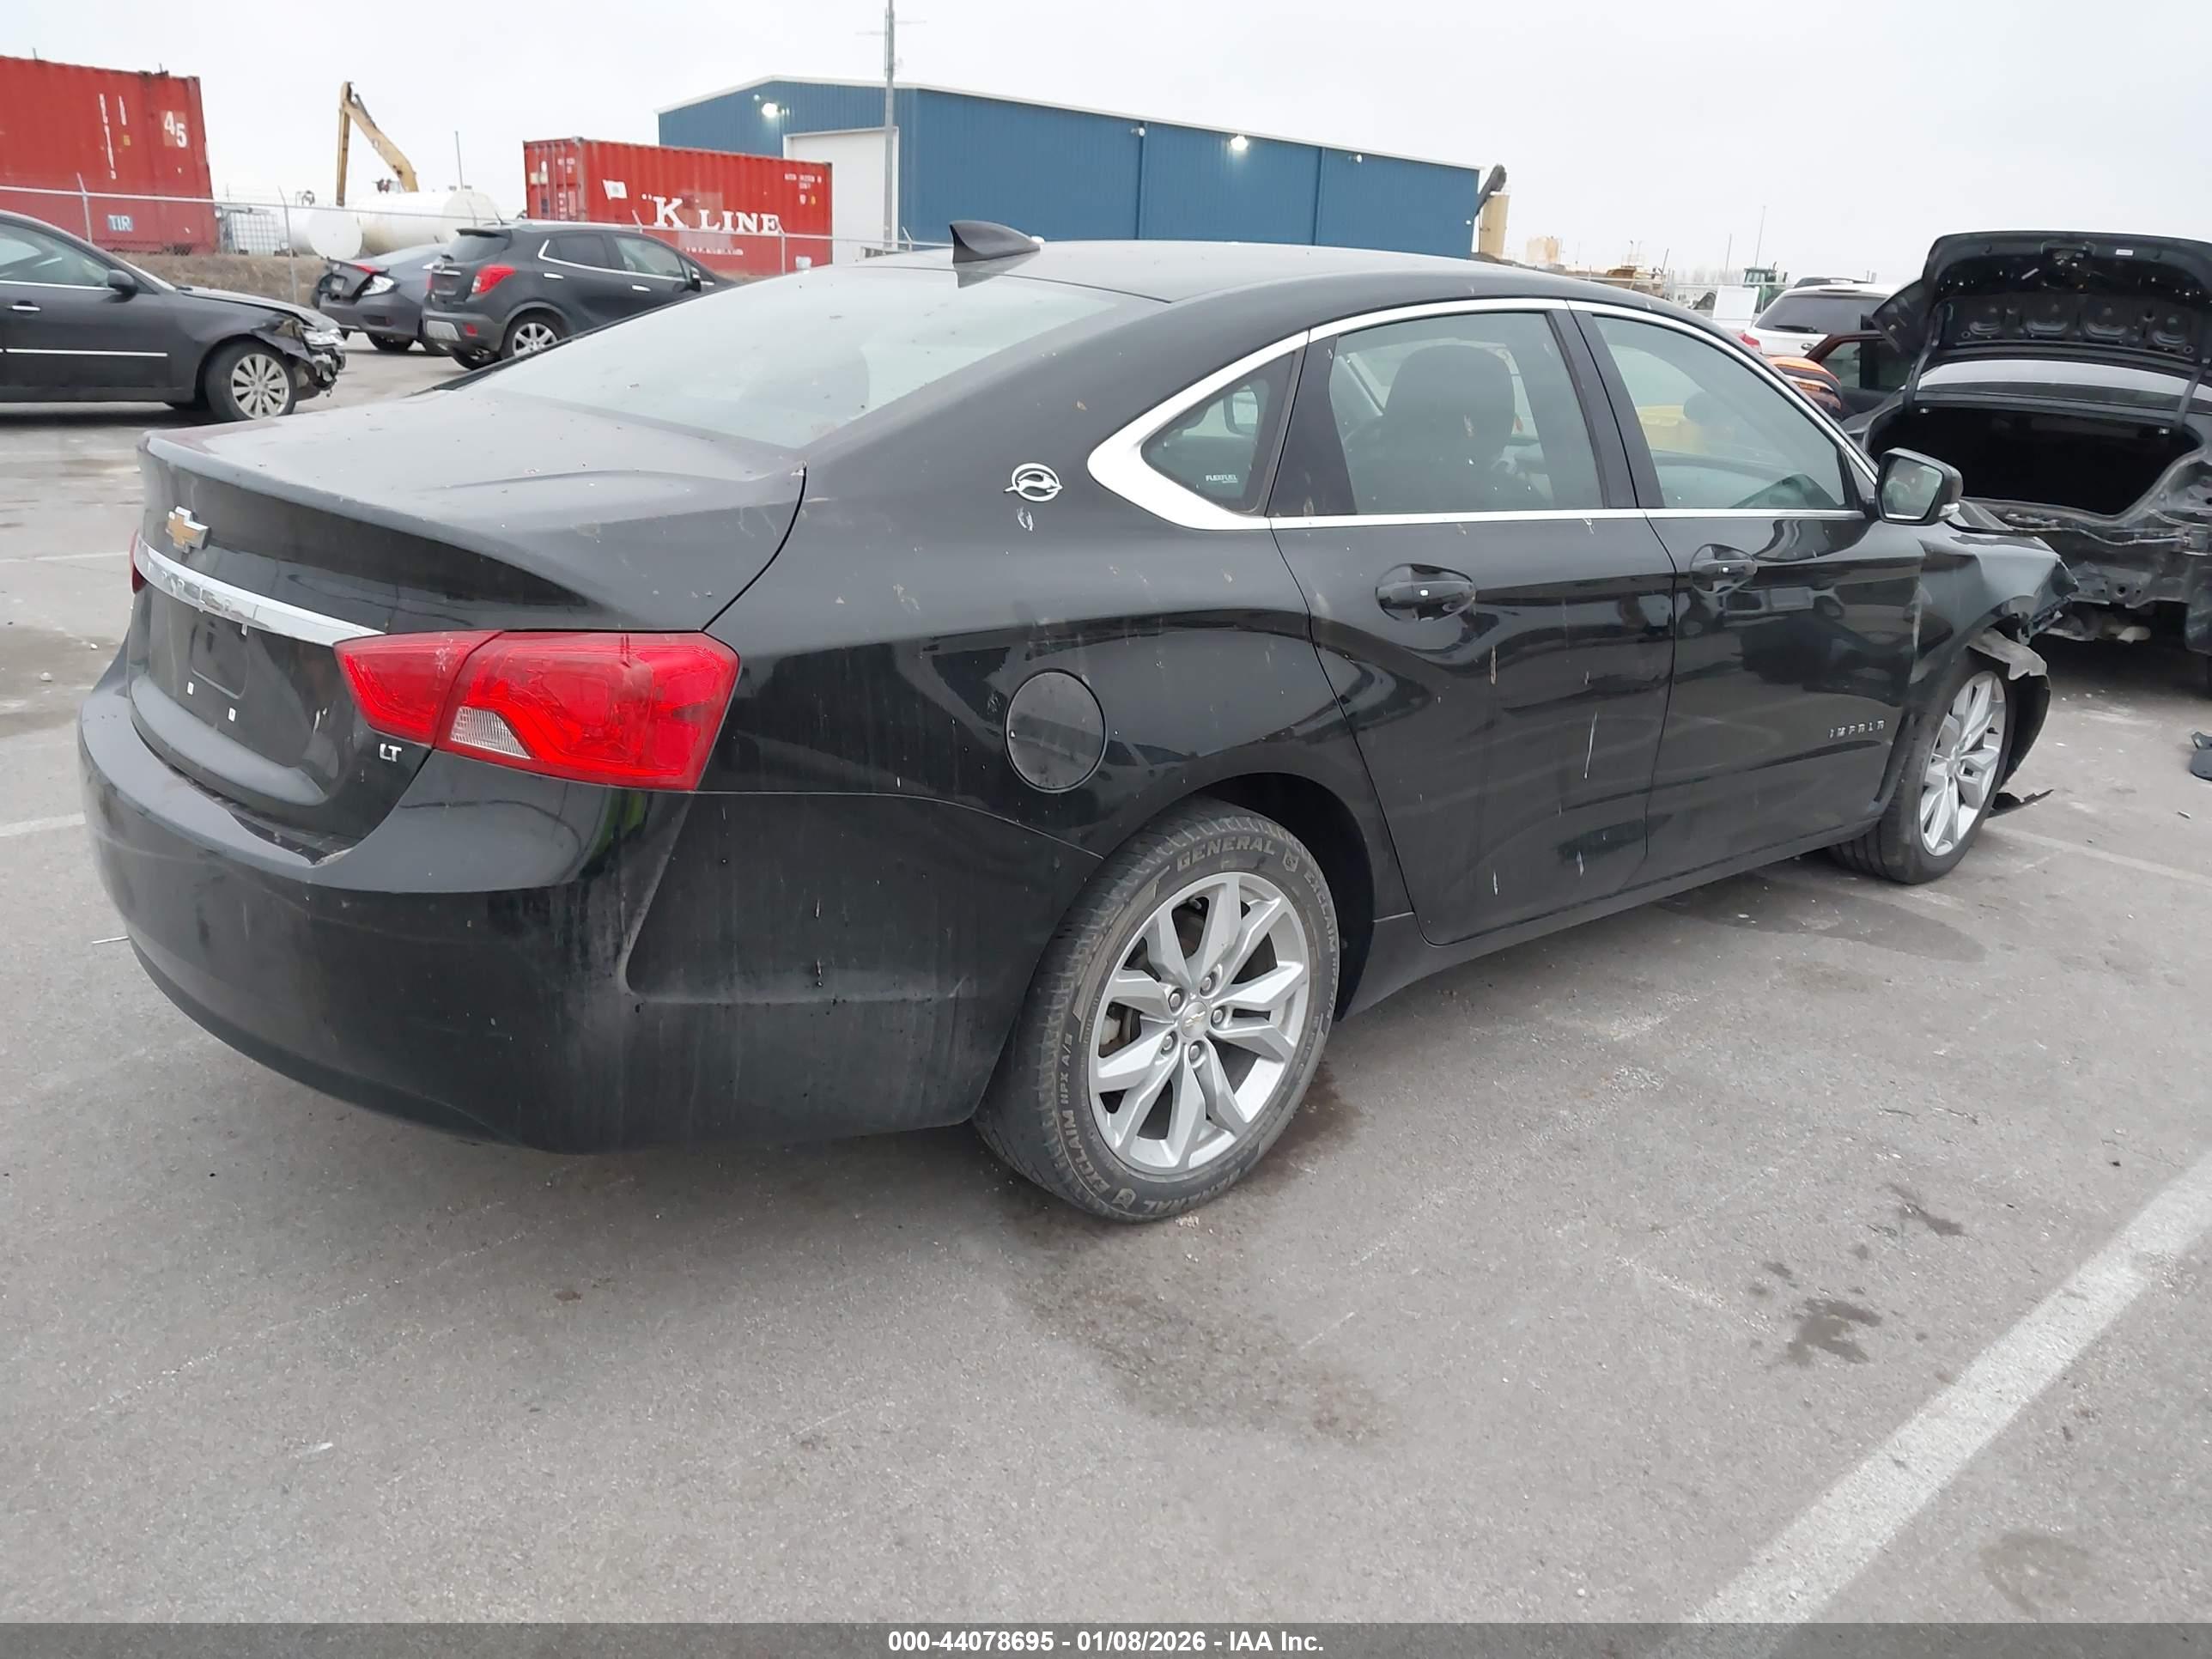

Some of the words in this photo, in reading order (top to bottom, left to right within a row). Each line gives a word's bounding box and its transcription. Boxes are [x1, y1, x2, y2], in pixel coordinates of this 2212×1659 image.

[163, 110, 187, 148] 45
[107, 214, 131, 232] TIR
[698, 209, 780, 235] LINE
[1829, 720, 1885, 738] IMPALA
[379, 743, 403, 763] LT
[1176, 836, 1276, 872] GENERAL
[1304, 871, 1335, 953] EXCLAIM
[1060, 1072, 1069, 1104] HPX
[1061, 1109, 1111, 1194] EXCLAIM
